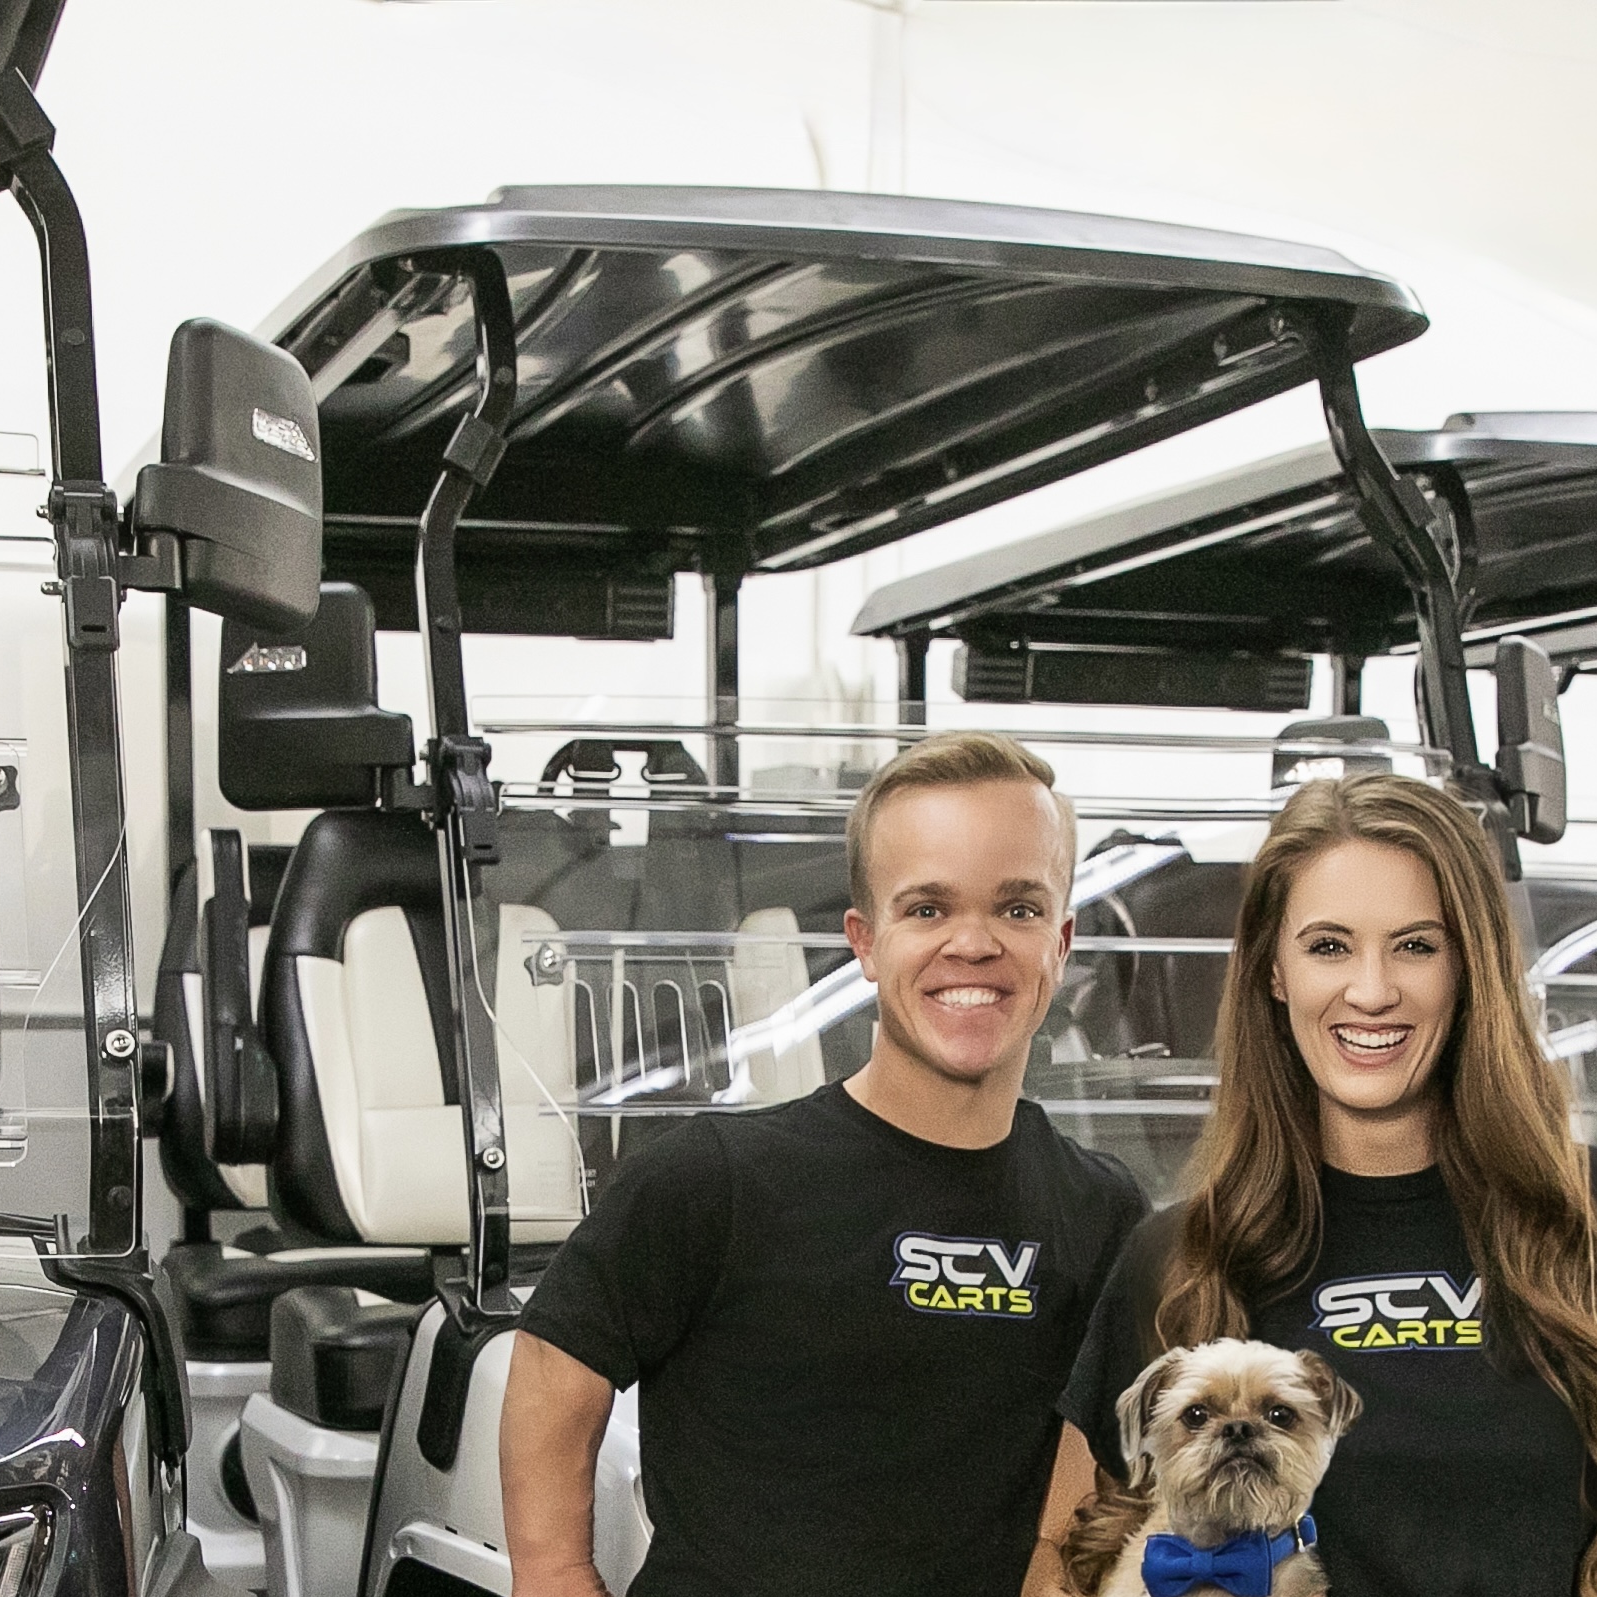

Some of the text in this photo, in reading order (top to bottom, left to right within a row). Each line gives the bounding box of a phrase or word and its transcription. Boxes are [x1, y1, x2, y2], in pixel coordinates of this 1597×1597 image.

[898, 1236, 1034, 1288] SCV
[909, 1282, 1033, 1313] CARTS
[1318, 1276, 1482, 1328] SCV
[1333, 1320, 1482, 1349] CARTS
